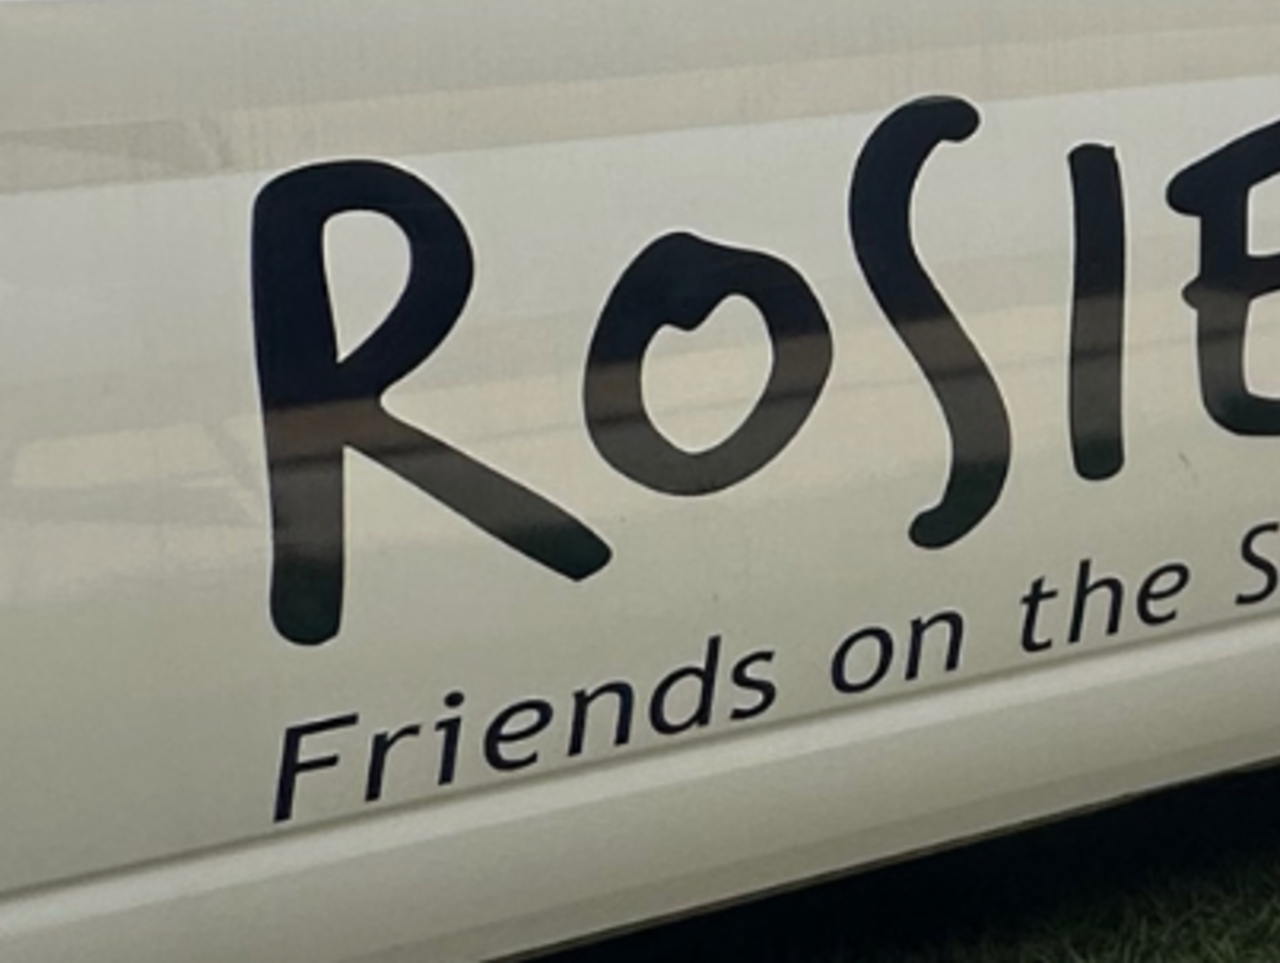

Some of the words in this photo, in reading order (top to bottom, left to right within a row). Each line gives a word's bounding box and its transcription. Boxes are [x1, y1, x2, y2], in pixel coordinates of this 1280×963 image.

[271, 633, 779, 825] Friends
[829, 609, 966, 695] on
[1020, 557, 1192, 654] the
